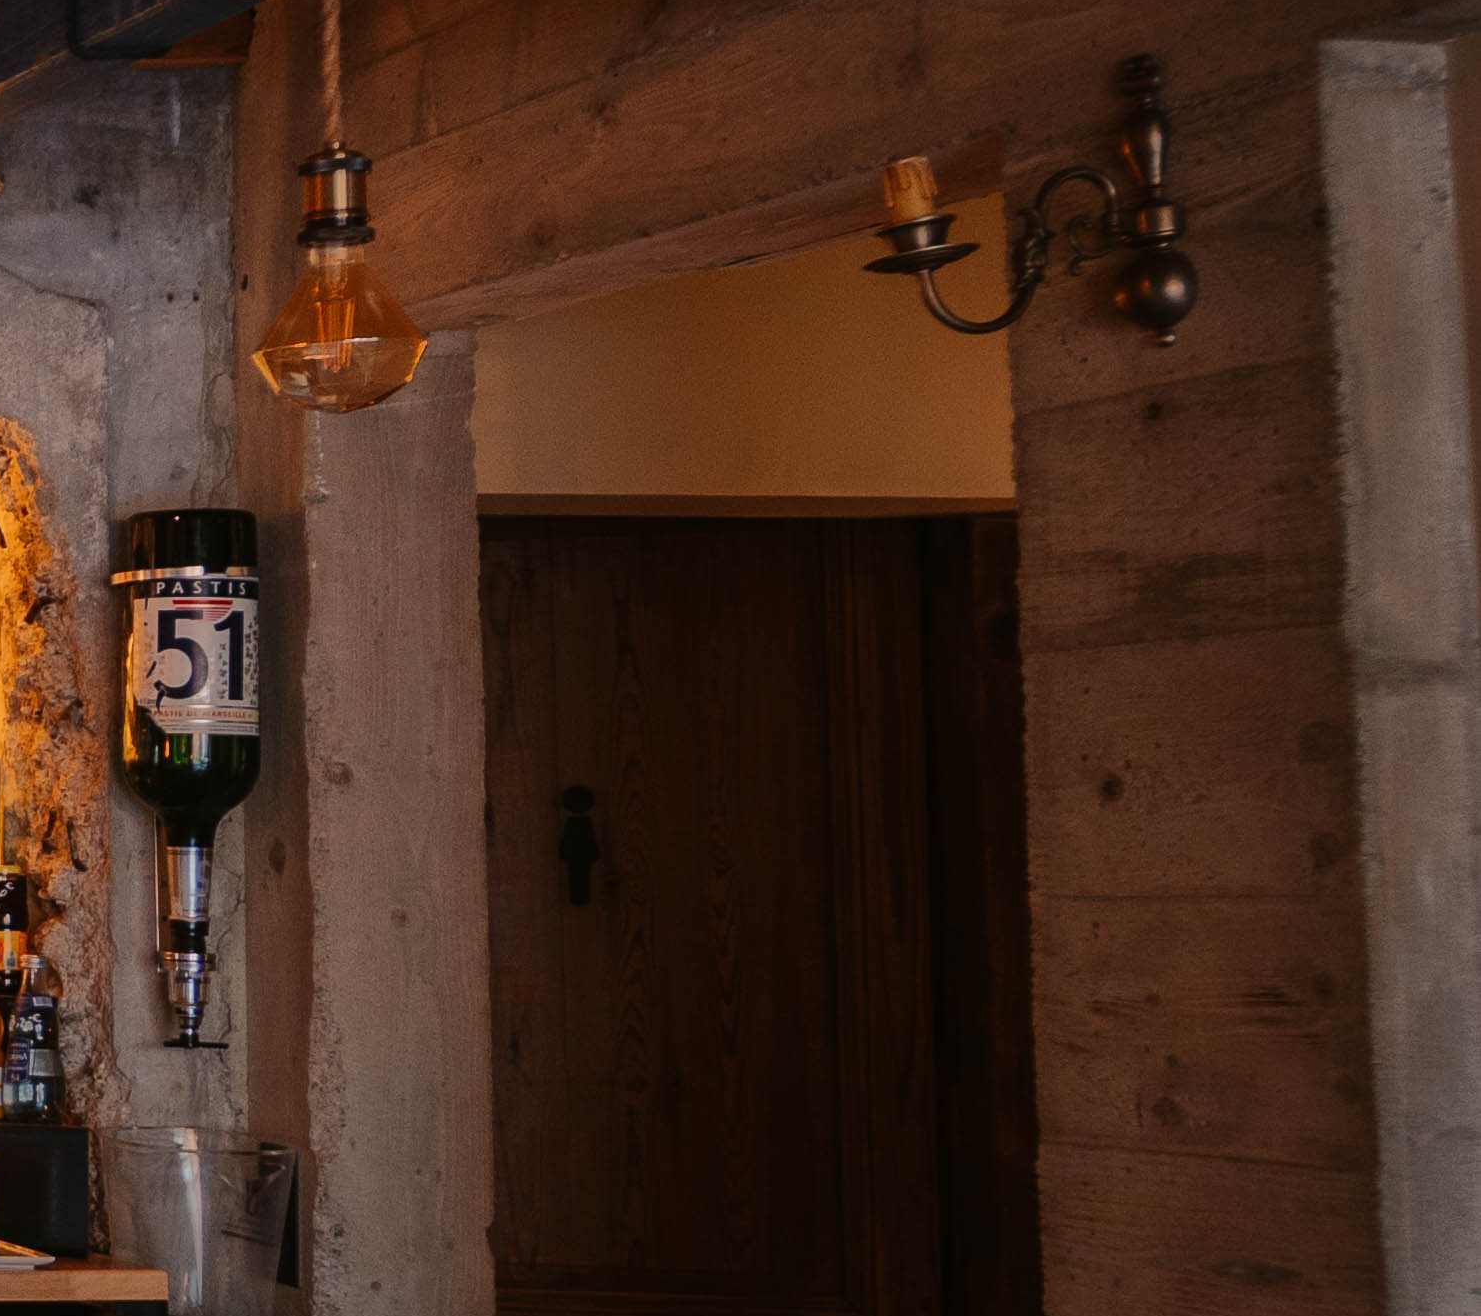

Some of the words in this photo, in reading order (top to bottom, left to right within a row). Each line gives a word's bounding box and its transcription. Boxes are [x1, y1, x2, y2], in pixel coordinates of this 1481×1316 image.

[156, 581, 246, 595] PASTIS
[153, 609, 245, 701] 51
[202, 709, 246, 719] ARSEILLE
